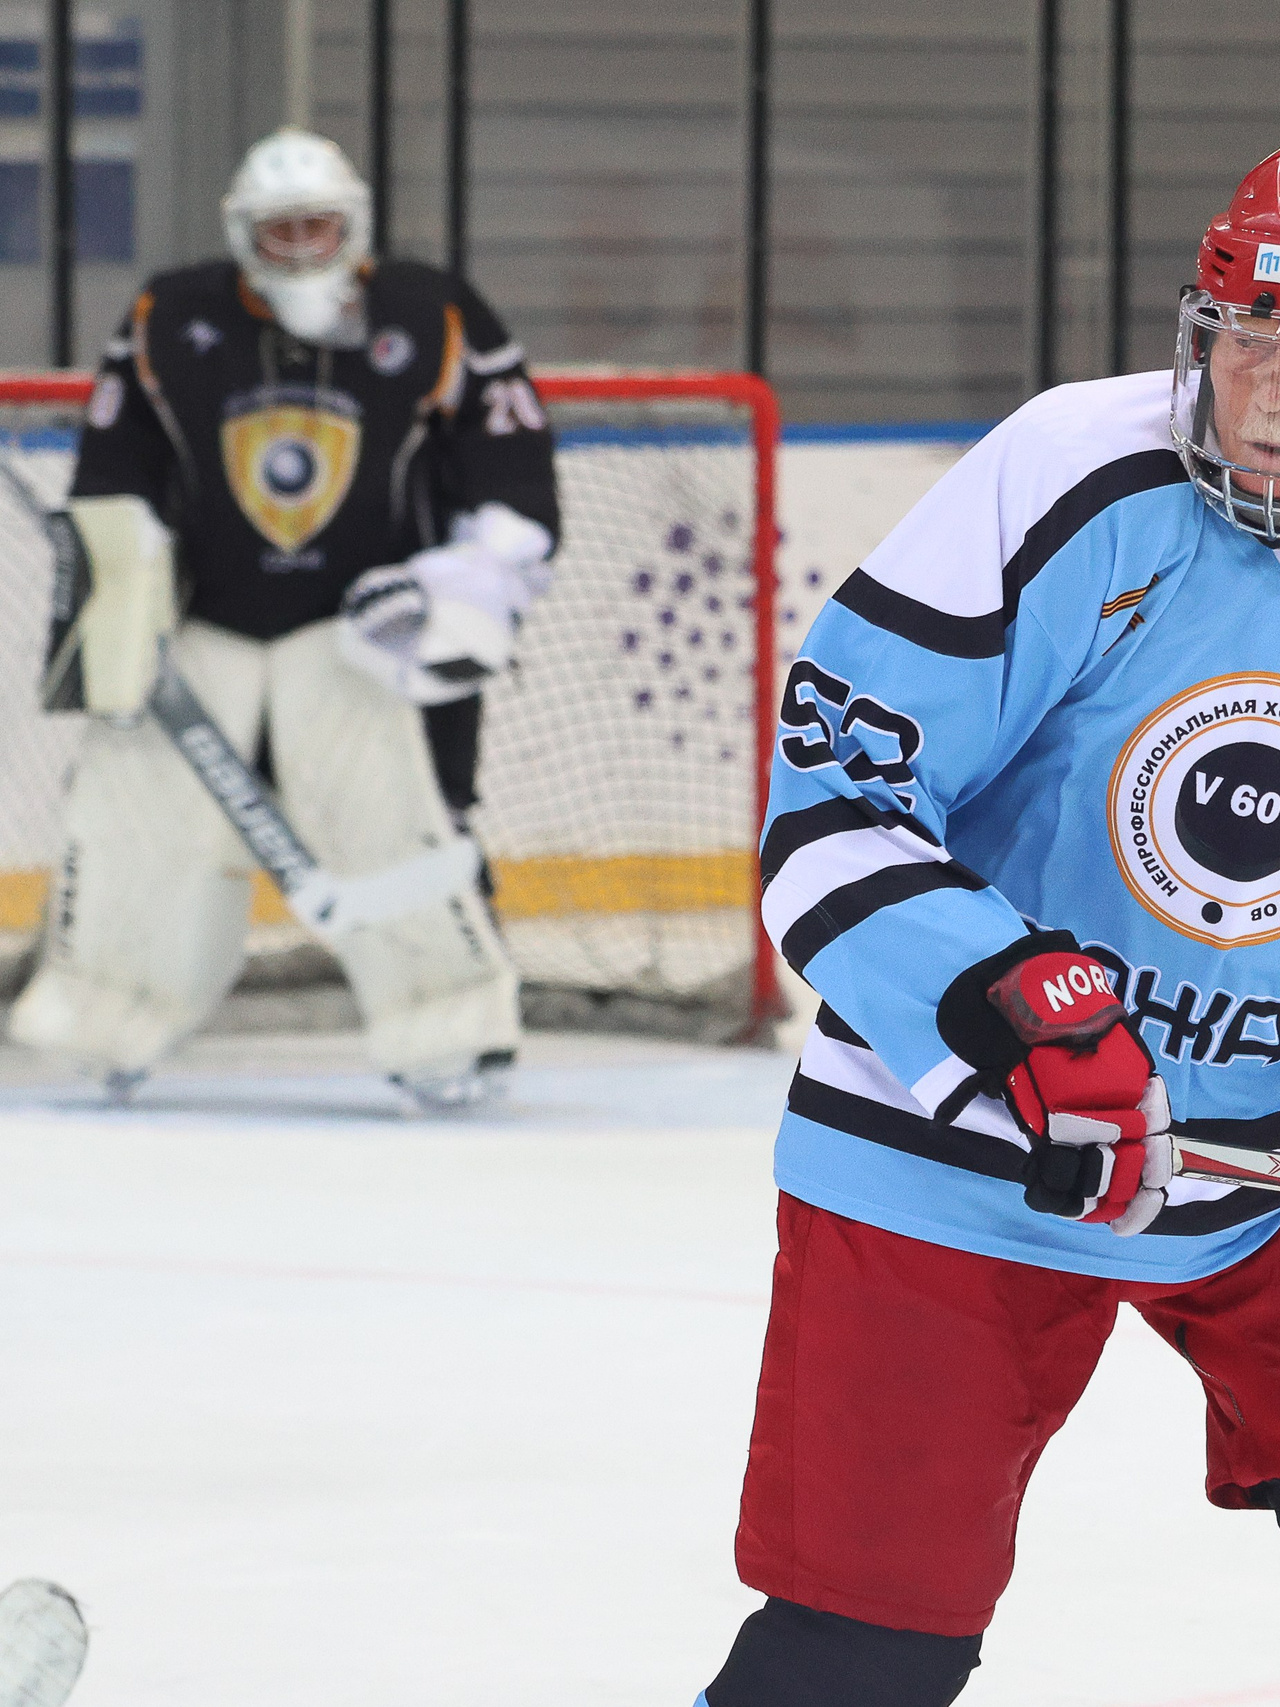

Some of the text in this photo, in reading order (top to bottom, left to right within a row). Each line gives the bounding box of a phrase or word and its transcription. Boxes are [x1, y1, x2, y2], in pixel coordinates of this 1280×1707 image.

[1129, 699, 1258, 898] НЕПРОФЕССИОНАЛЬНАЯ
[1194, 770, 1225, 806] V
[1042, 964, 1117, 1014] NOR
